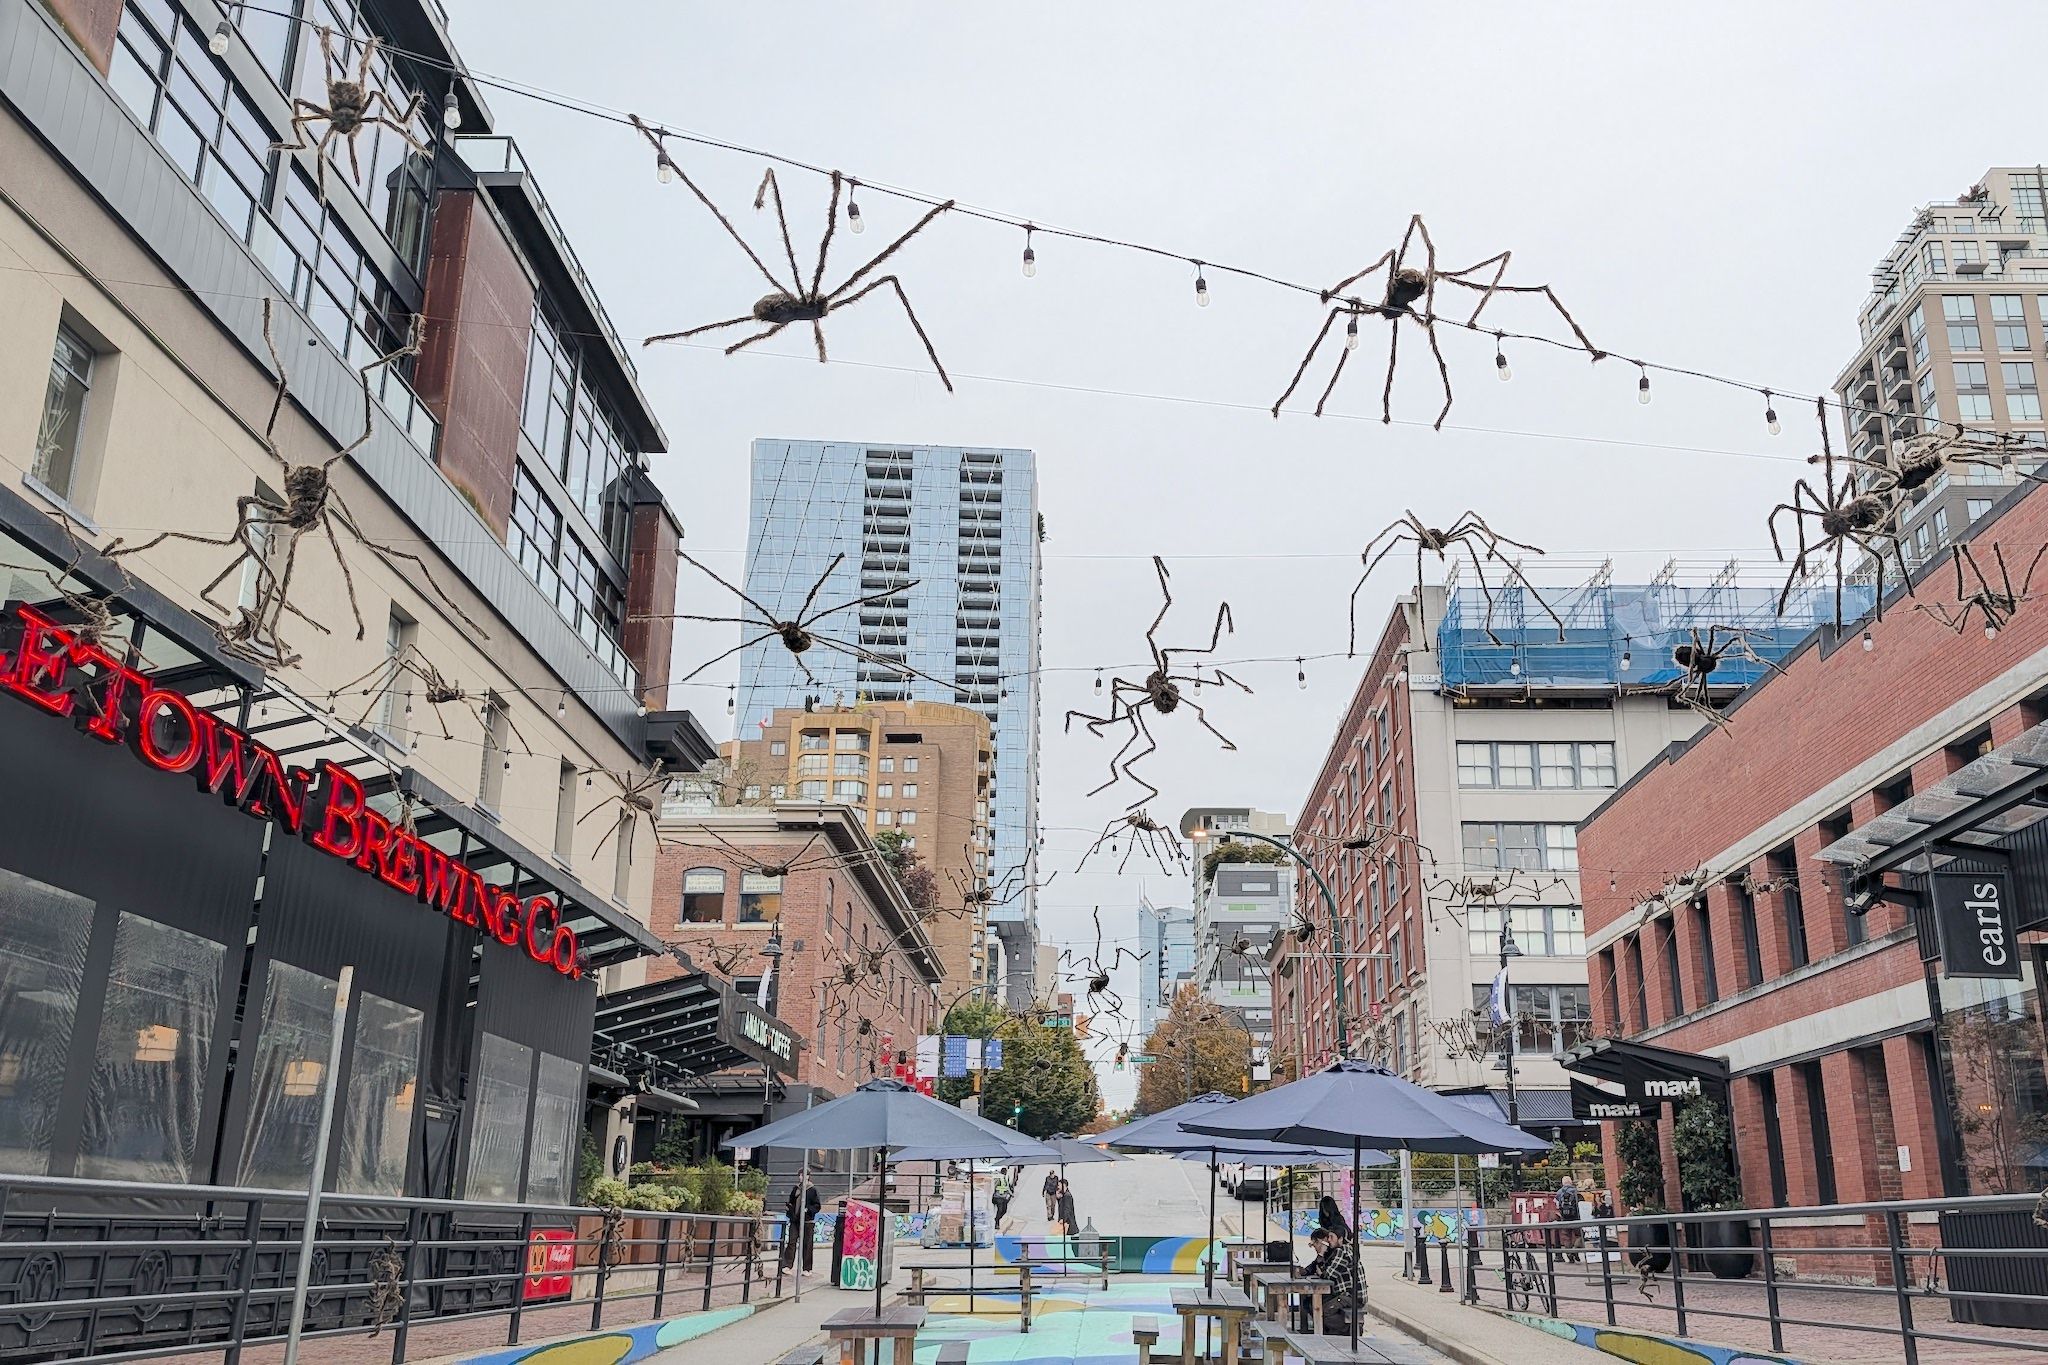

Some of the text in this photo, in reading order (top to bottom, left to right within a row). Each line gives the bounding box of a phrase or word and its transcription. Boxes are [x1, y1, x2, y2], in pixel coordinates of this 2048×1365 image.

[312, 759, 522, 946] BREWING
[1963, 882, 2007, 966] earls
[770, 1027, 791, 1061] COFFEE
[1643, 1076, 1701, 1097] mavi
[1588, 1101, 1641, 1117] mavi
